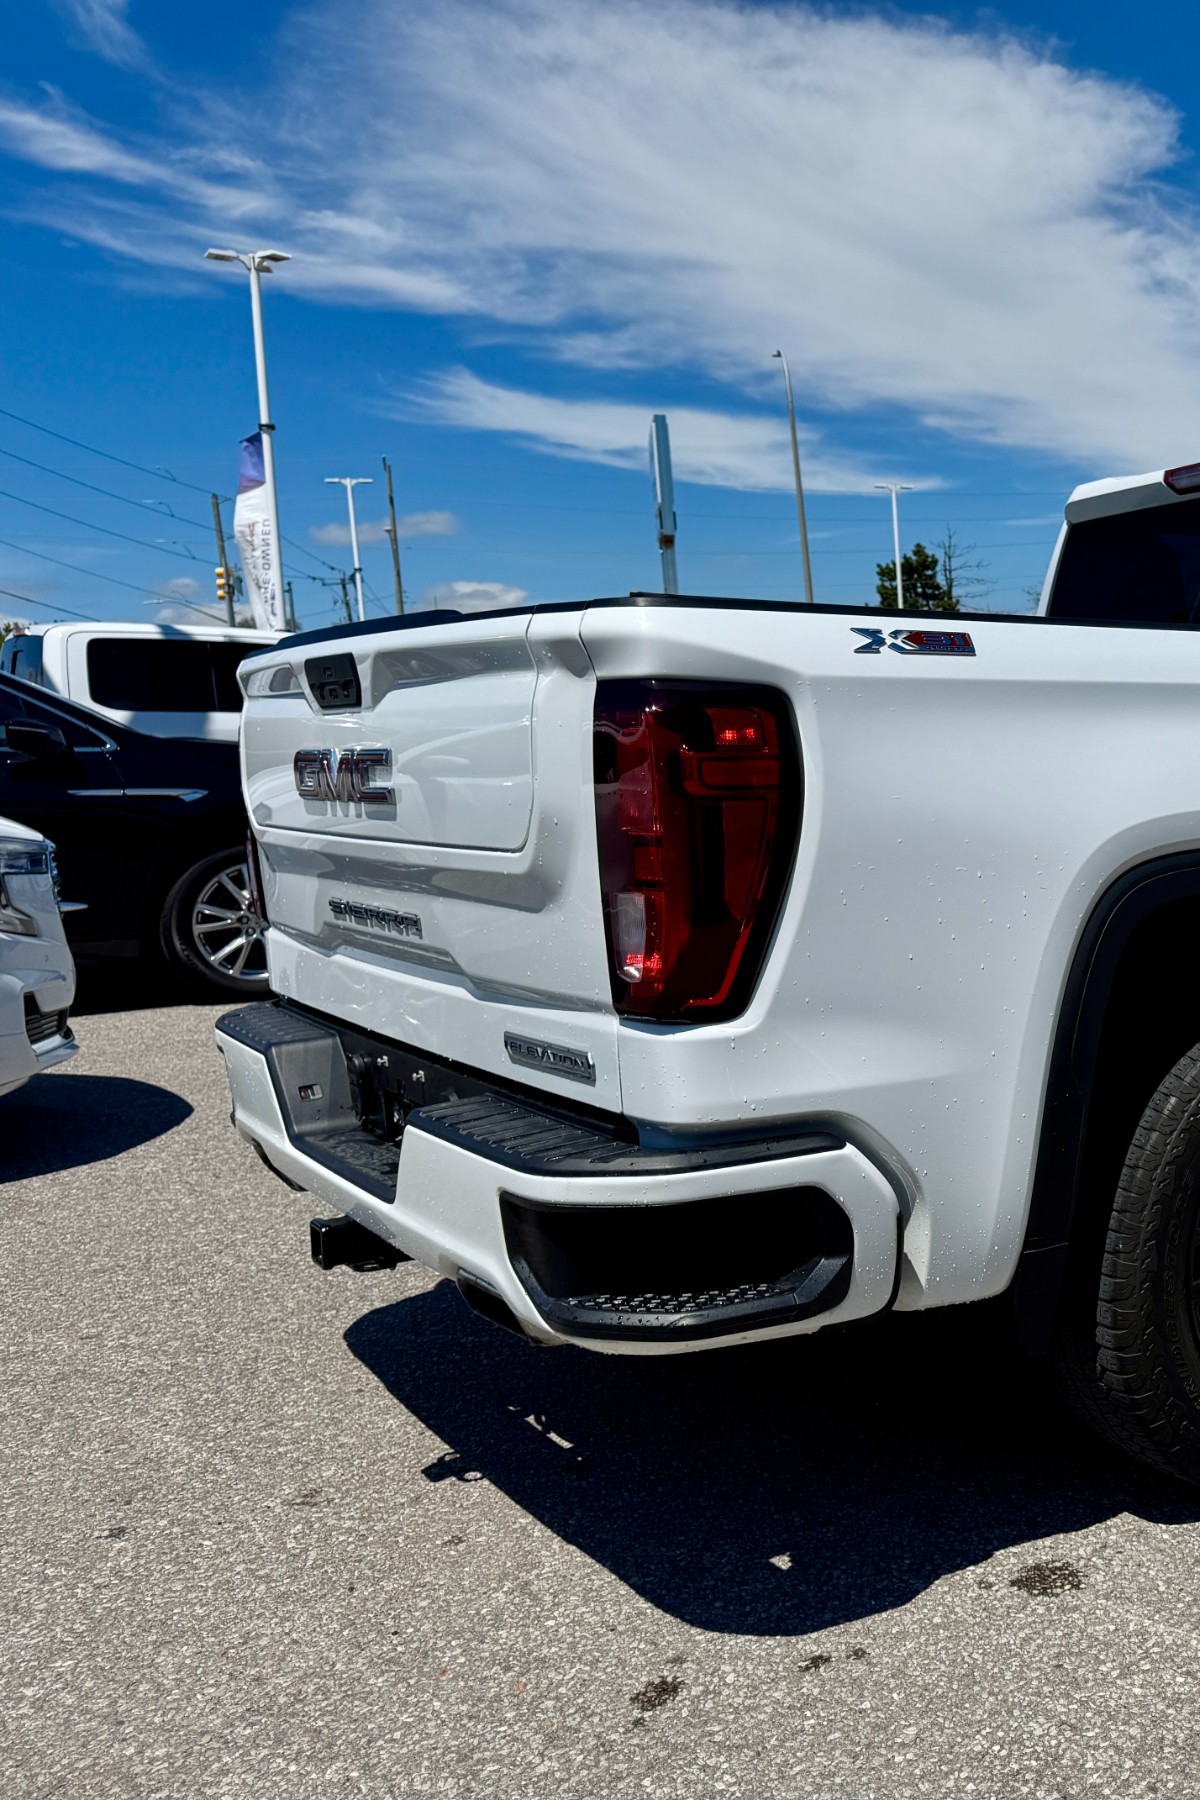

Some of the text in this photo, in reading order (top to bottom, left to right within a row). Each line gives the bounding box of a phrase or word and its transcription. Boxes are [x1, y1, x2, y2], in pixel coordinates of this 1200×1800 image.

[294, 748, 396, 806] GMC
[328, 897, 423, 933] SIERRA
[510, 1041, 585, 1069] ELEVATION
